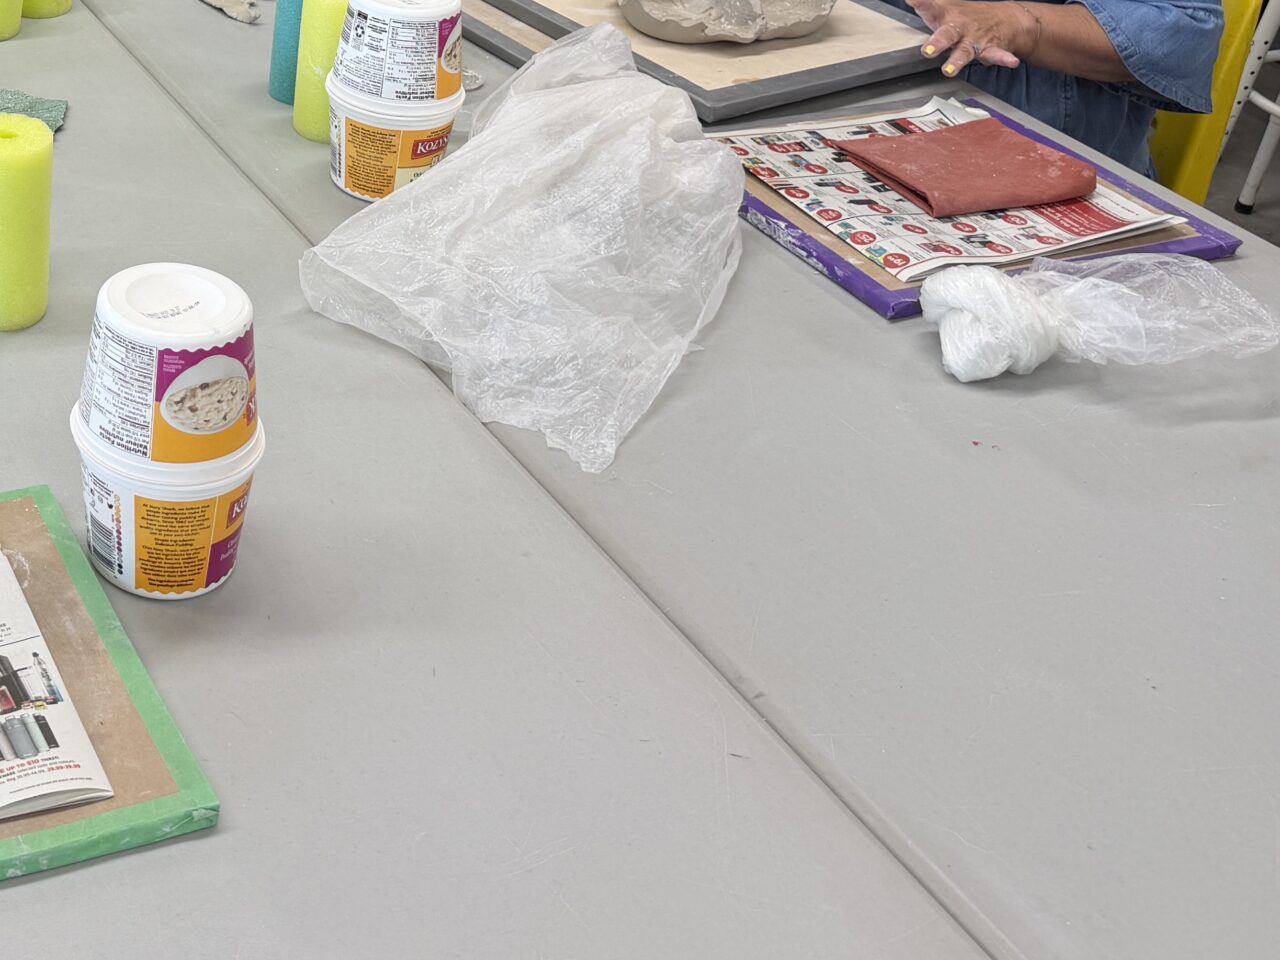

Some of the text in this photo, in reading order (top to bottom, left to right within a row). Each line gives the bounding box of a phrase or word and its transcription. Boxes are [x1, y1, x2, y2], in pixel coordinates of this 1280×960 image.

[99, 425, 148, 450] Valeur nutritive
[99, 431, 148, 457] Nutrition Facts
[26, 758, 40, 767] $10
